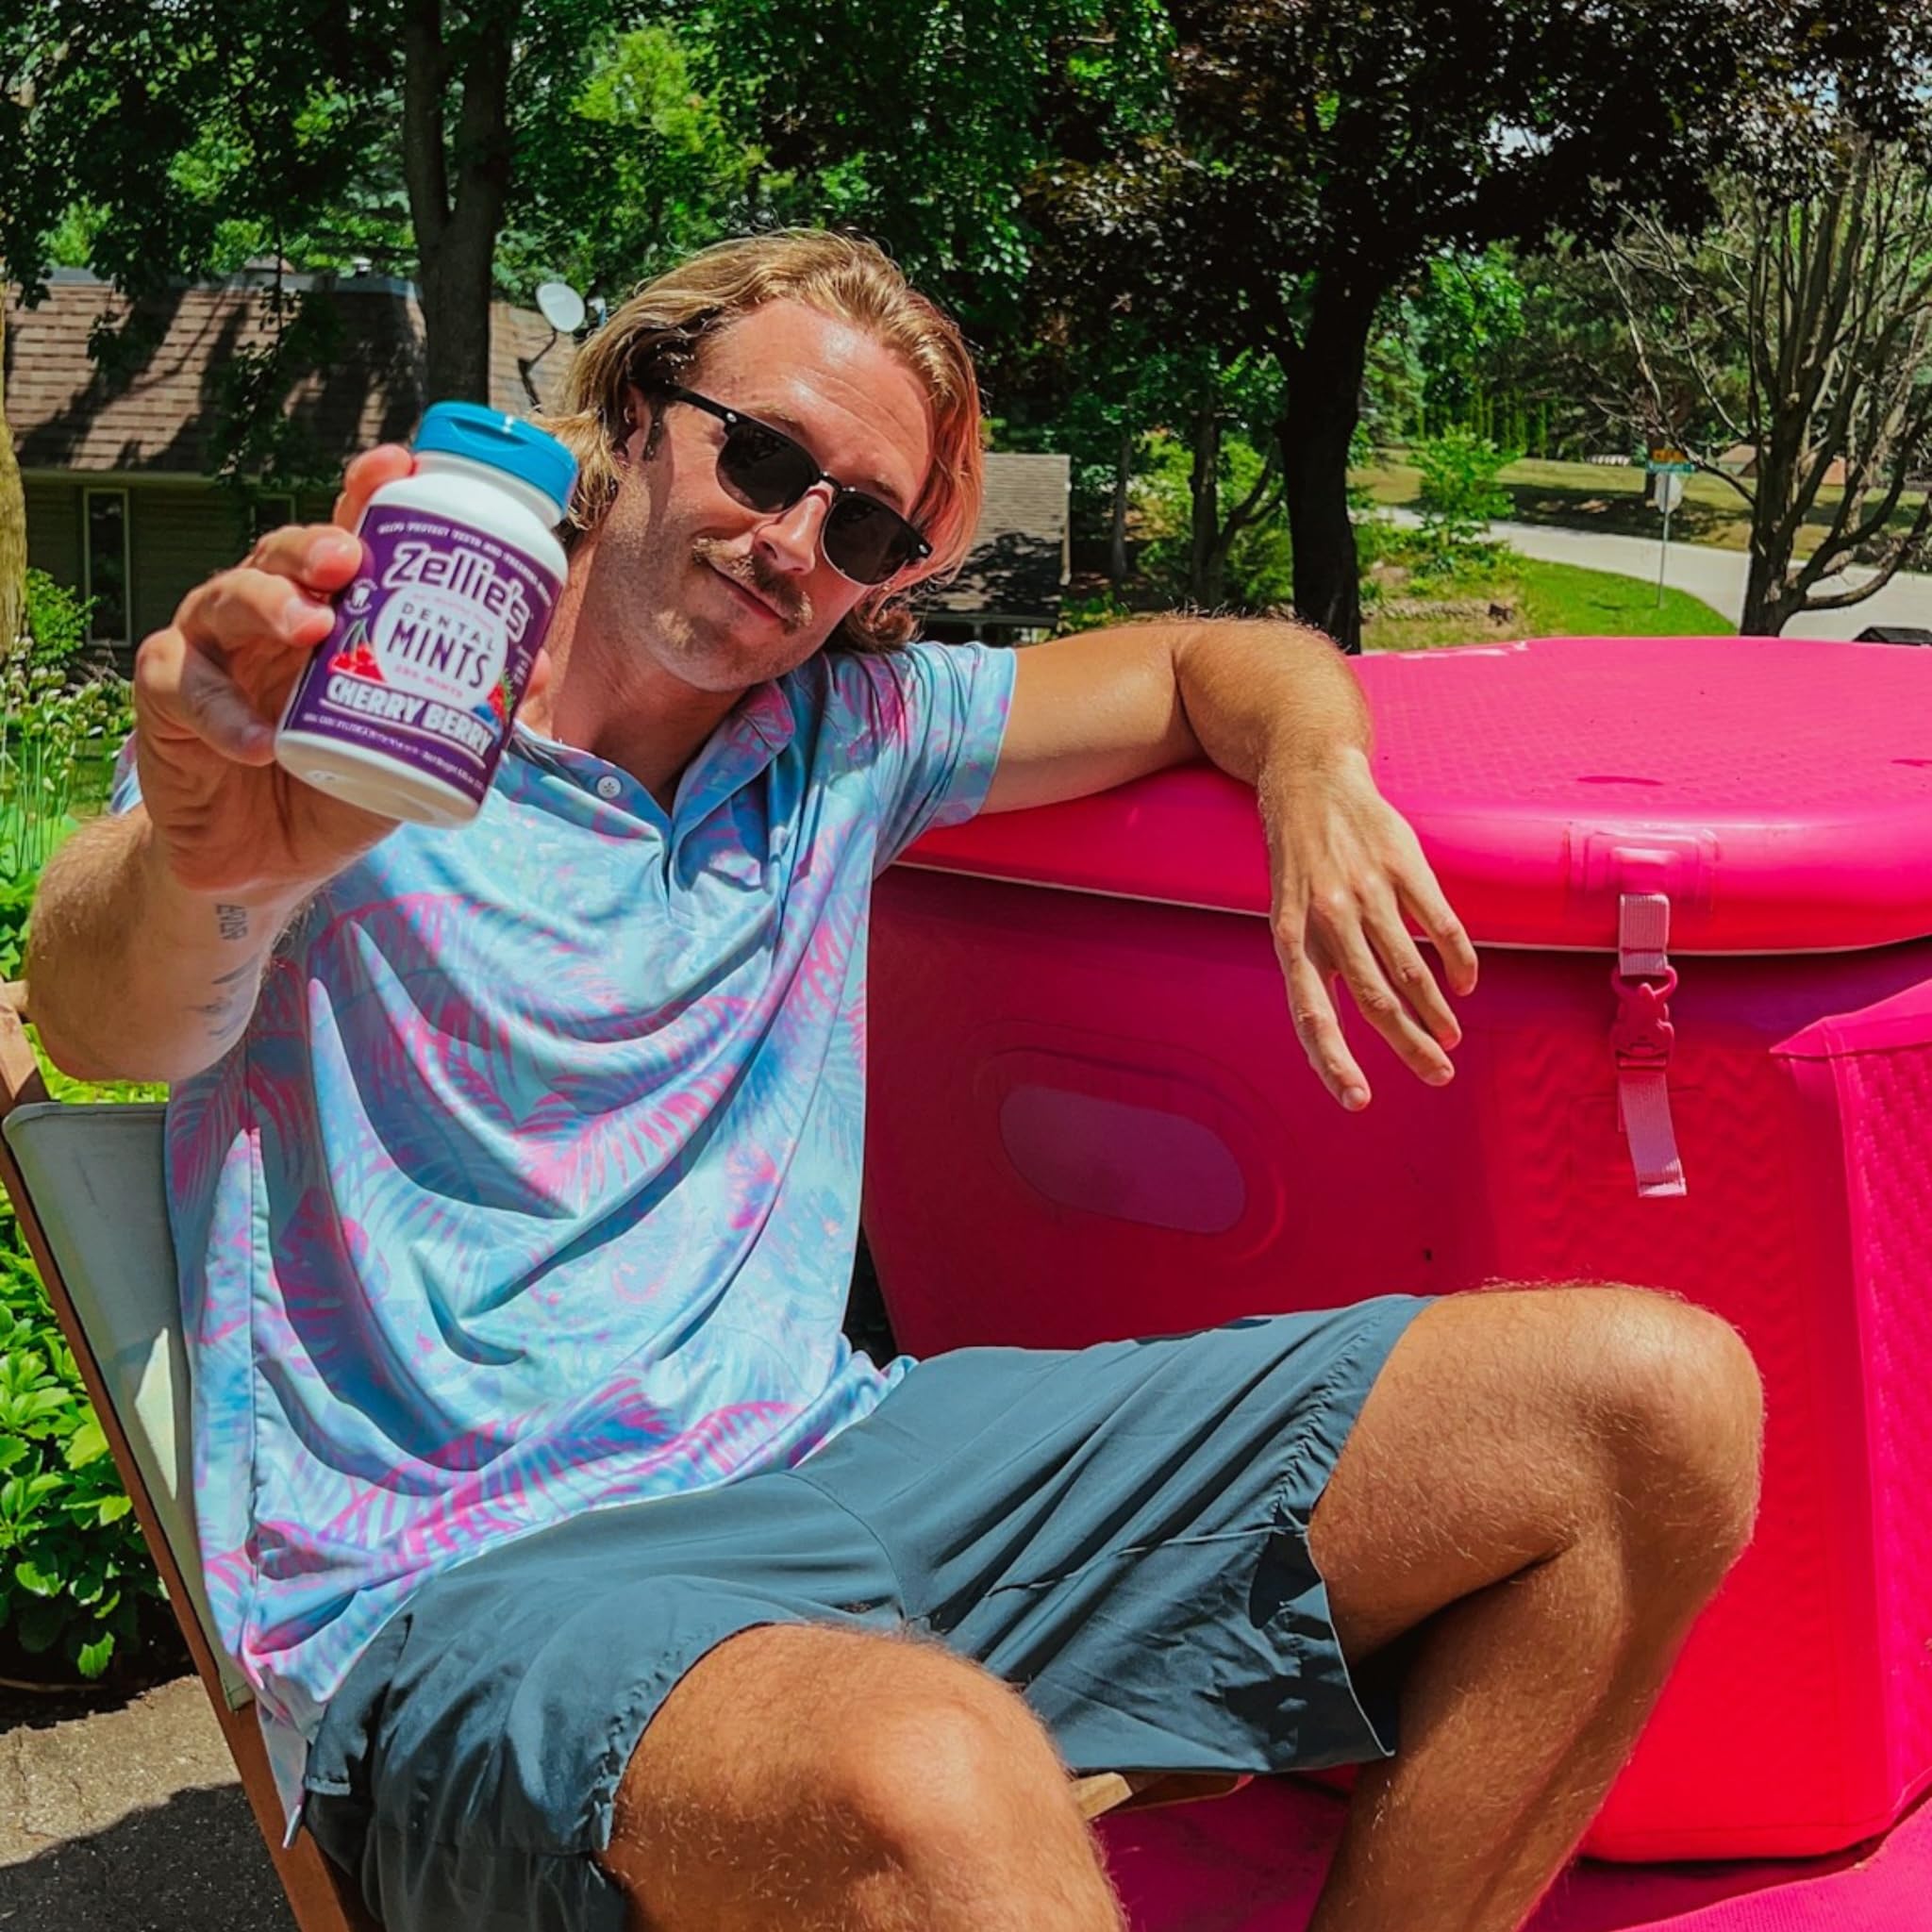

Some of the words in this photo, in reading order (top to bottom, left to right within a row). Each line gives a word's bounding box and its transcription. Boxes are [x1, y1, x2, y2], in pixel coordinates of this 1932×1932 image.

[382, 542, 530, 641] Zellie's
[402, 602, 495, 652] DENTAL
[386, 618, 490, 690] MINTS
[327, 675, 425, 724] CHERRY
[423, 701, 492, 757] BERRY
